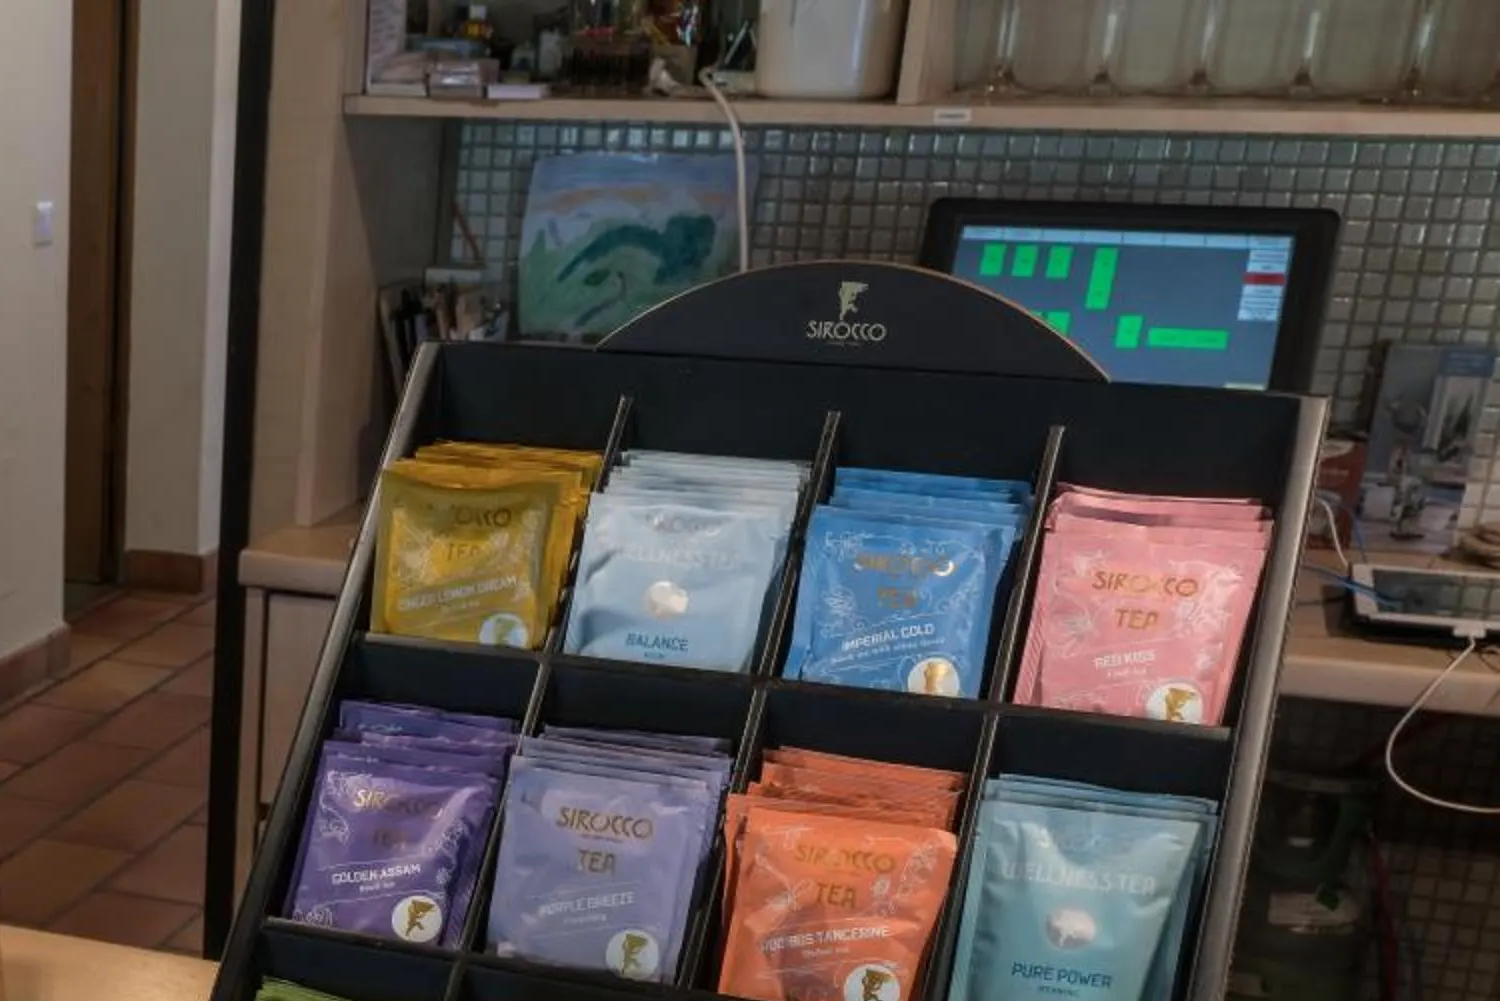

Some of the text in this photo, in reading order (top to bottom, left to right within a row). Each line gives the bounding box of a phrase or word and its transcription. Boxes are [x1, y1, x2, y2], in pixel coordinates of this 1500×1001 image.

[806, 320, 887, 341] SIROCCO
[1091, 570, 1199, 597] SIROCCO
[1115, 607, 1159, 630] TEA
[625, 632, 689, 651] BALANCE
[841, 630, 899, 651] IMPERIAL
[901, 622, 935, 637] GOLD
[556, 806, 654, 840] SIROCCO
[380, 863, 421, 879] ASSAM
[578, 848, 617, 875] TEA
[794, 844, 896, 874] SIROCCO
[815, 882, 857, 908] TEA
[816, 924, 891, 943] TANGERINE
[1011, 961, 1113, 989] PURE POWER
